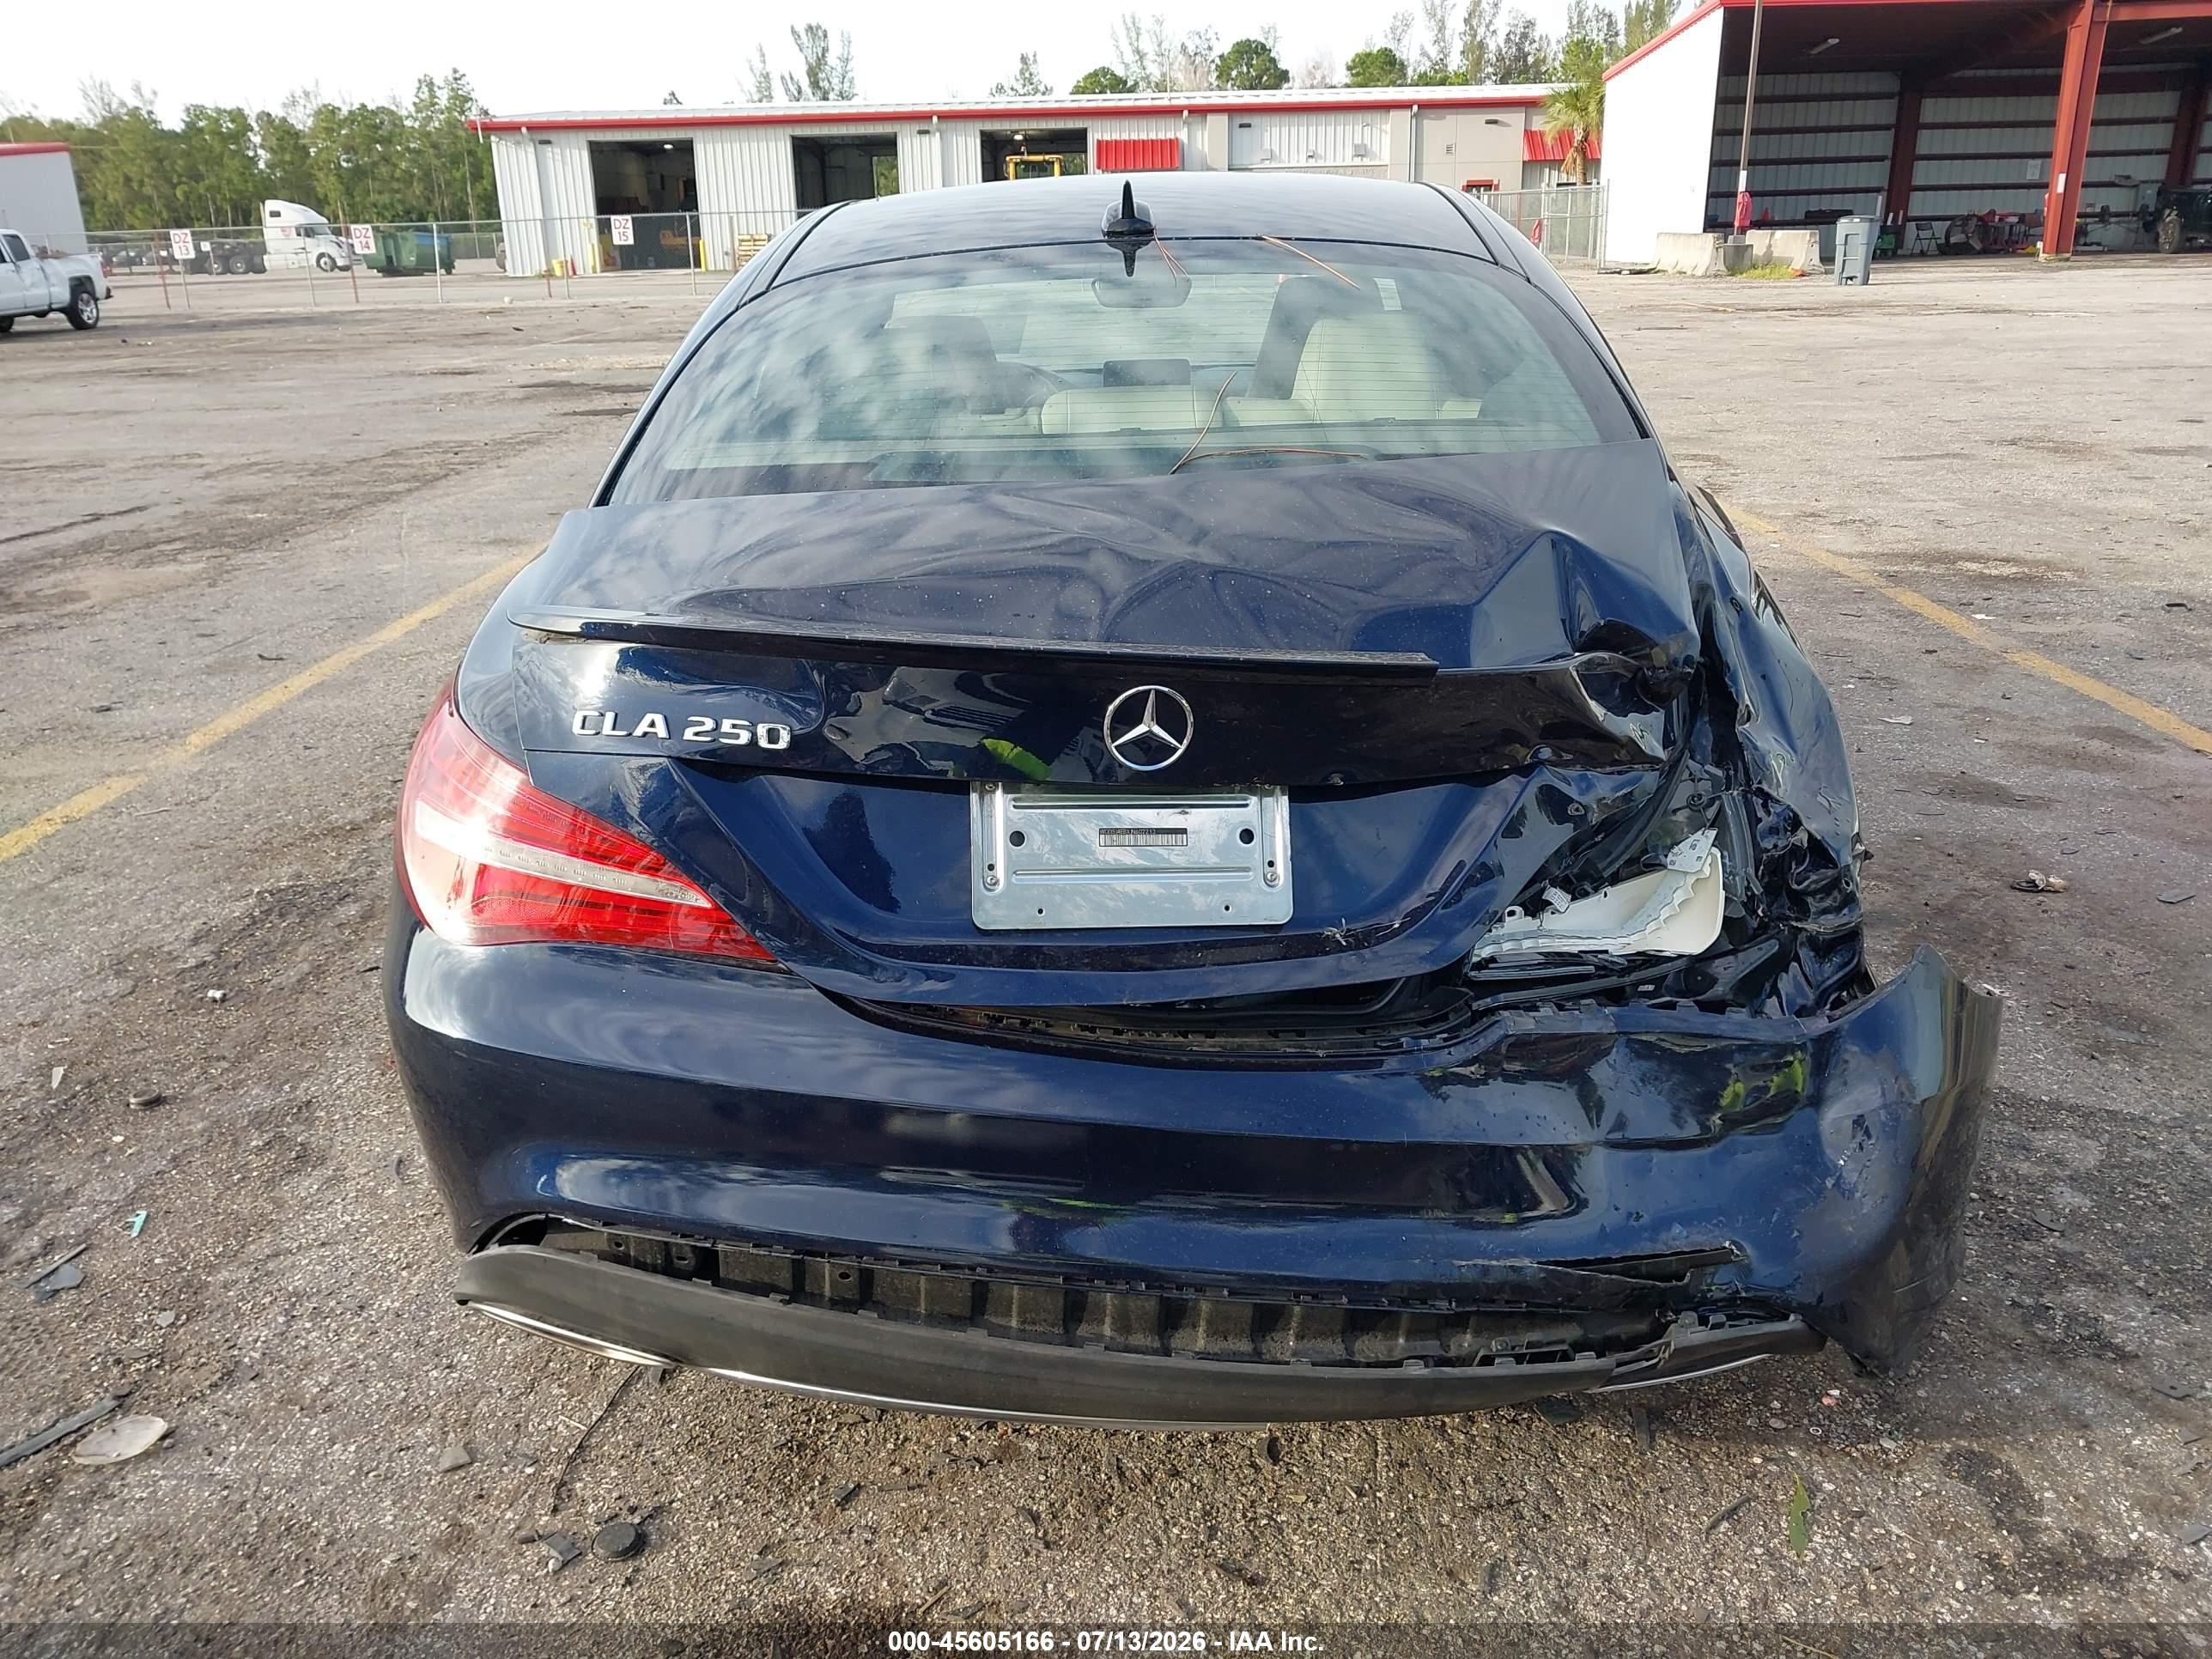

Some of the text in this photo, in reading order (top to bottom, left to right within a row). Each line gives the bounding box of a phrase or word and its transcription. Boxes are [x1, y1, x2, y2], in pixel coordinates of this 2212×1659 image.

[612, 217, 630, 230] DZ
[173, 232, 190, 244] DZ
[353, 227, 371, 240] DZ
[617, 231, 629, 242] 15
[178, 245, 190, 256] 13
[359, 240, 371, 251] 14
[571, 709, 793, 750] CLA 250
